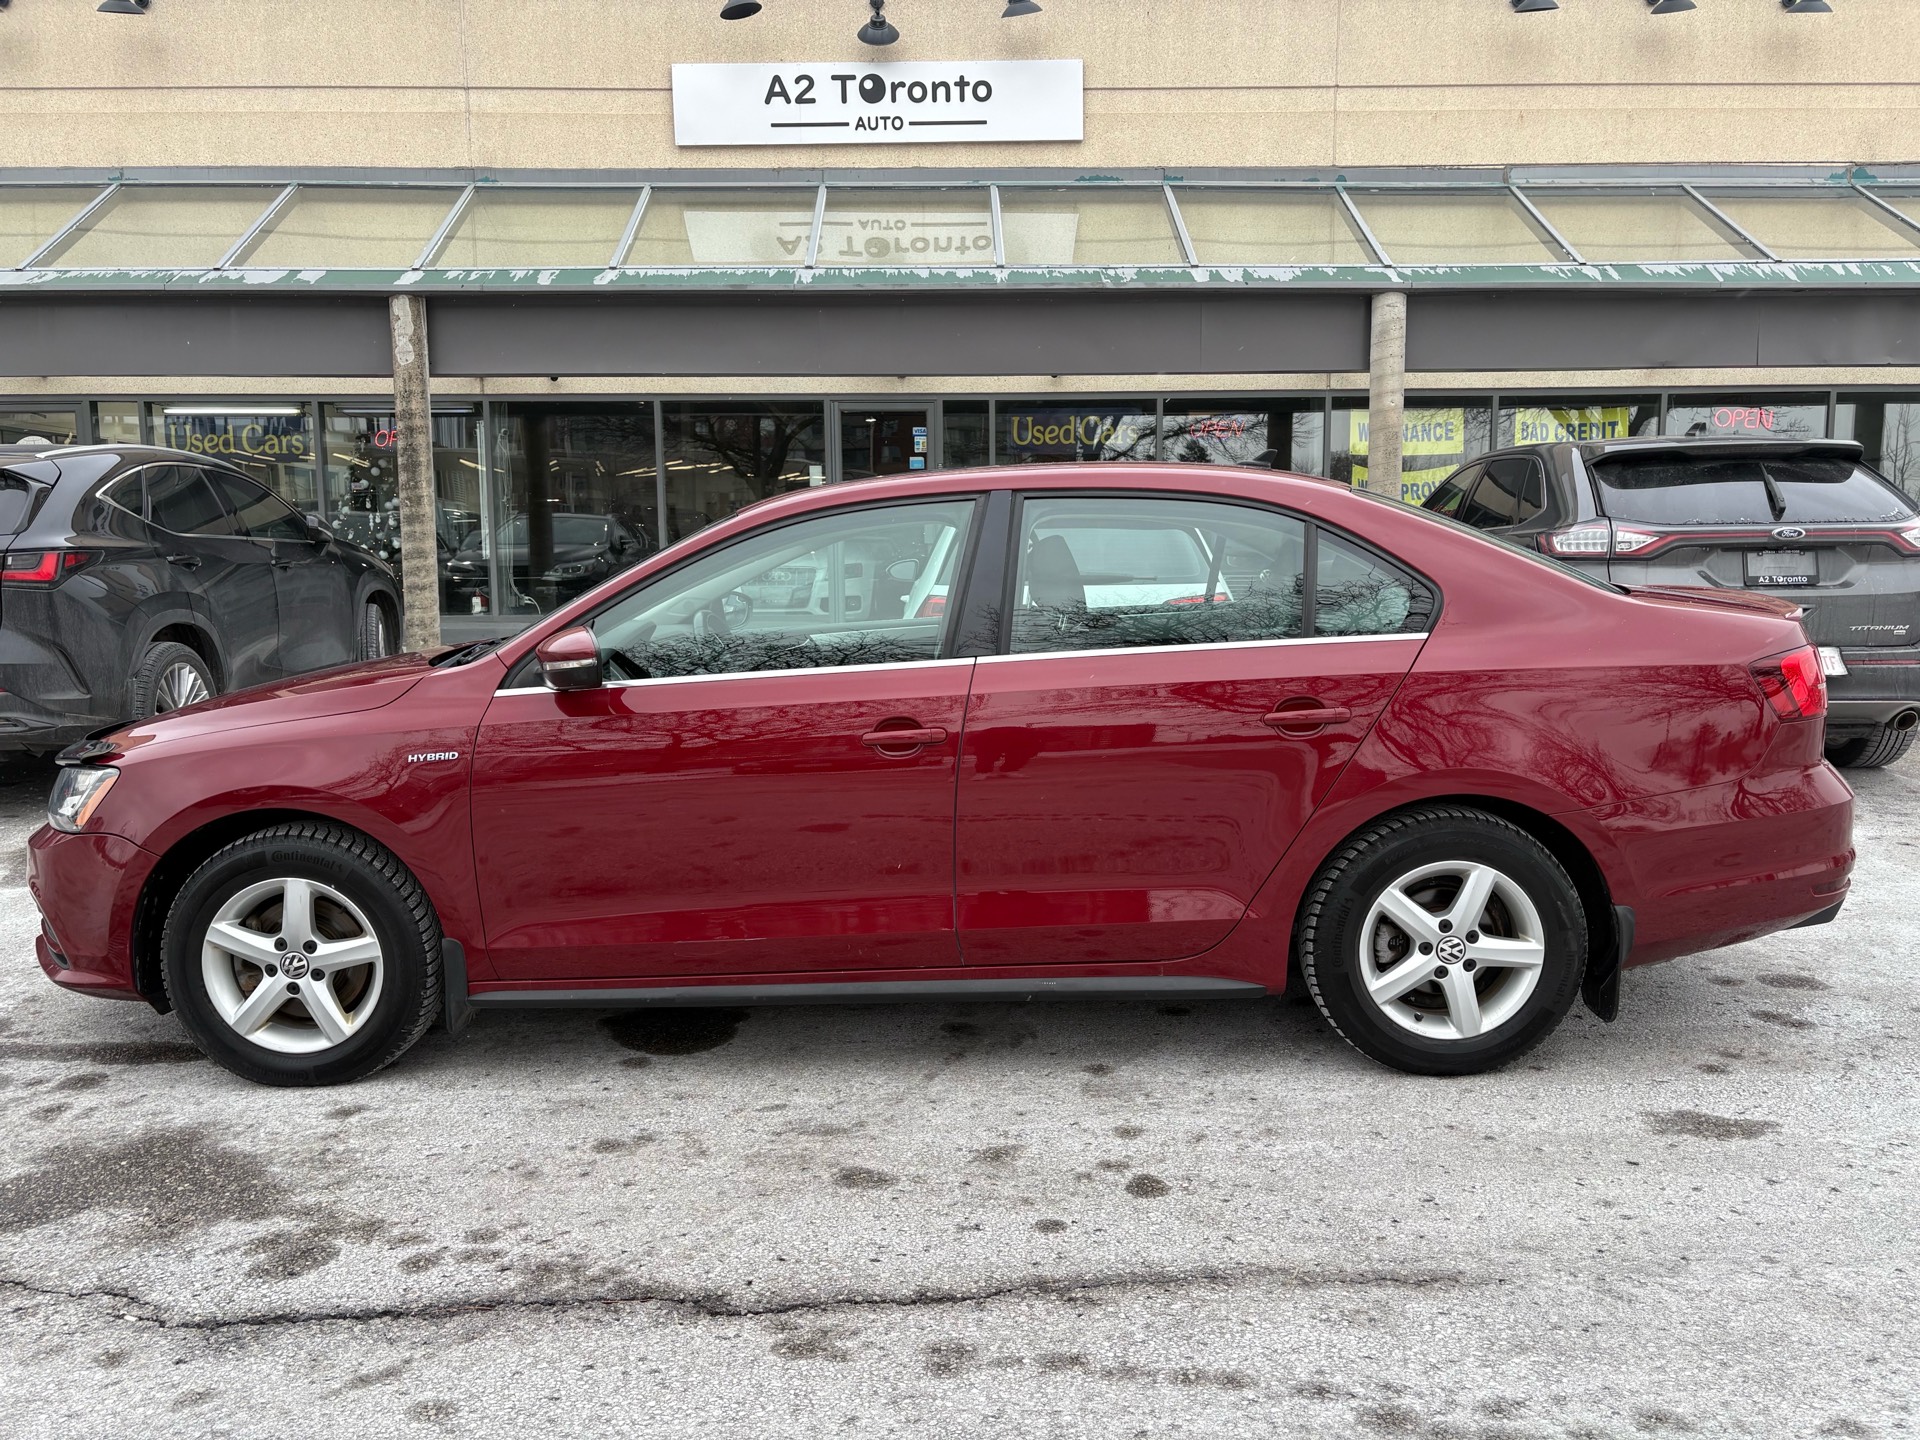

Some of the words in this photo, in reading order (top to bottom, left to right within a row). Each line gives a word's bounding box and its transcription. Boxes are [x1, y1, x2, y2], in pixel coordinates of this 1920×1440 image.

[764, 75, 816, 104] A2
[855, 116, 904, 131] AUTO
[1714, 408, 1774, 429] OPEN
[169, 424, 235, 453] Used
[242, 424, 304, 454] Cars
[1012, 415, 1076, 446] Used
[1080, 415, 1138, 446] Cars
[1189, 420, 1245, 439] OPEN
[1521, 421, 1549, 442] BAD
[1554, 420, 1619, 442] CREDIT
[407, 751, 459, 763] HYBRID
